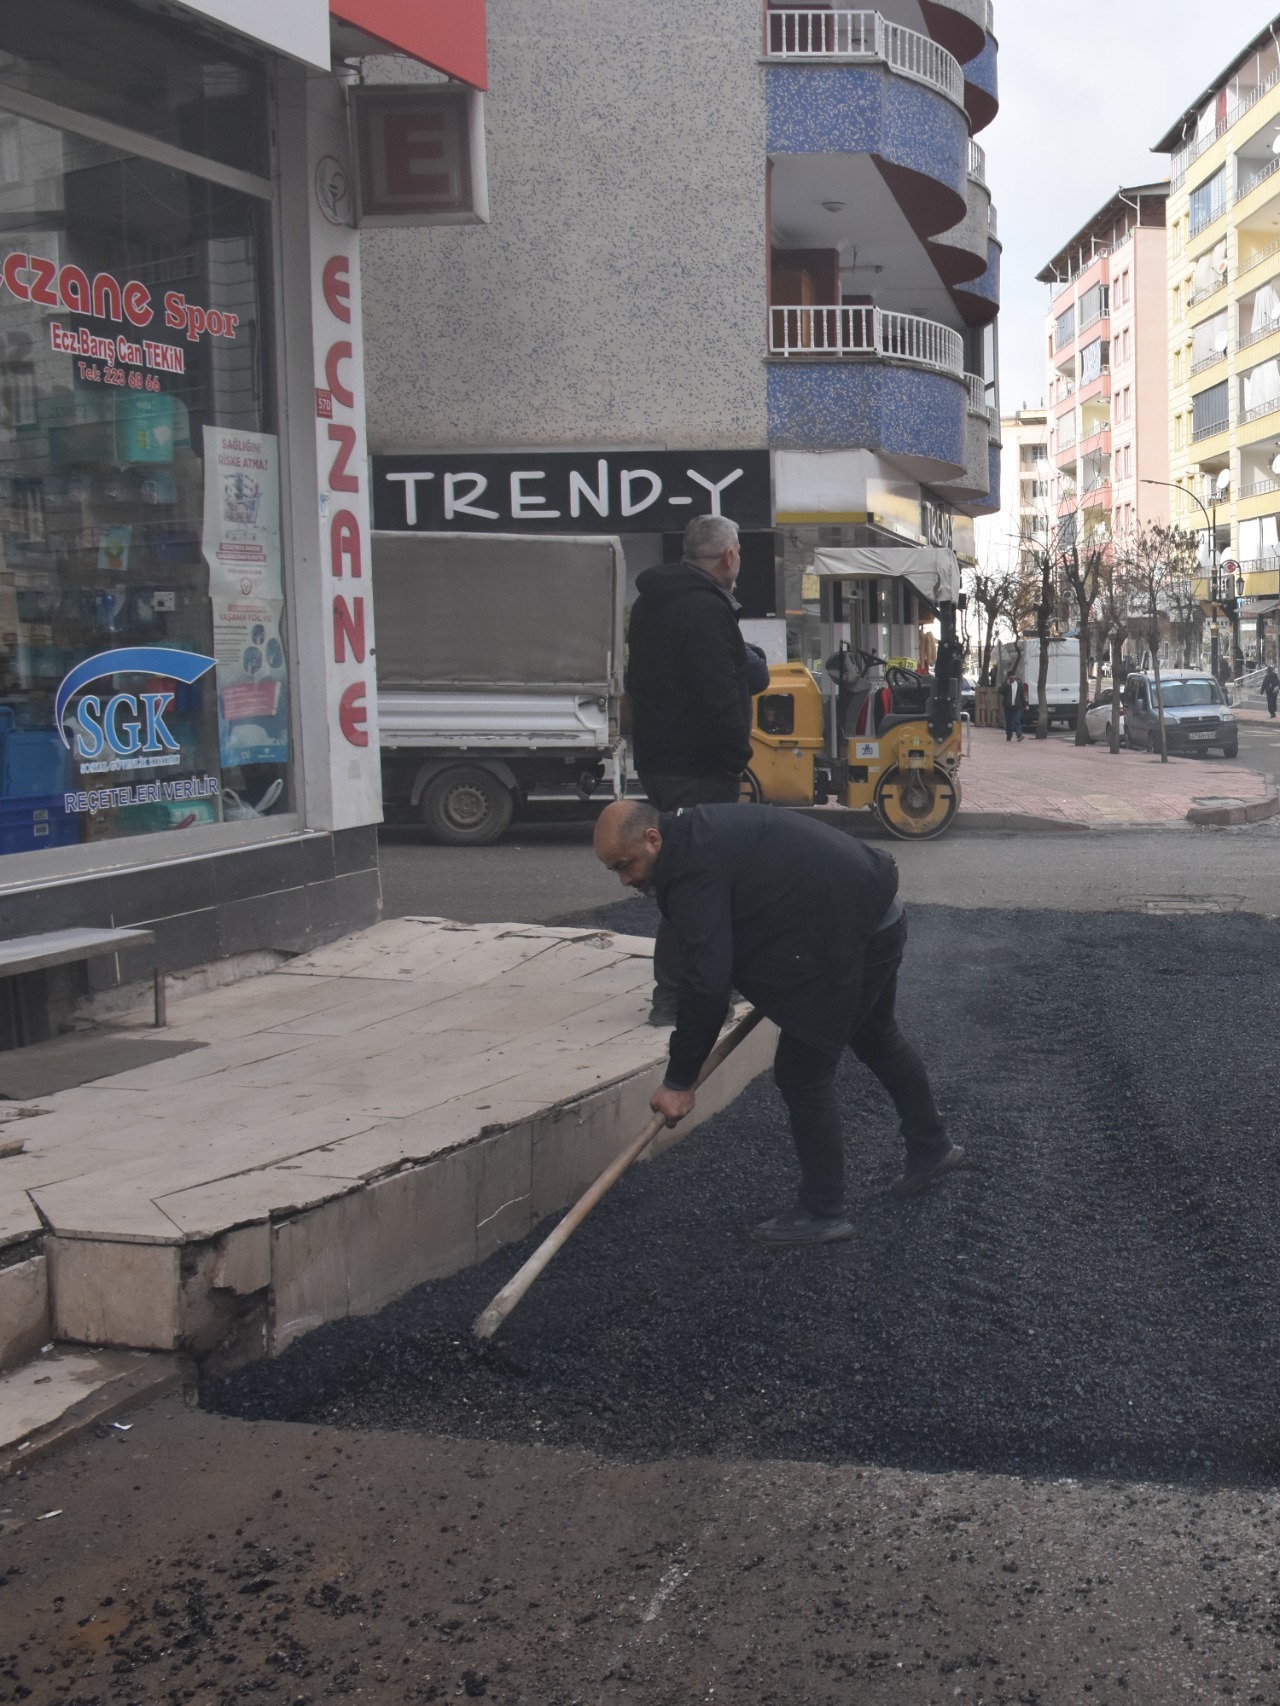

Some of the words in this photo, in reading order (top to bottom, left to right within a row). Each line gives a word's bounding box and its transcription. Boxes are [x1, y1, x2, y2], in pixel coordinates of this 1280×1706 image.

[385, 112, 450, 196] E
[0, 252, 154, 327] czane
[164, 291, 239, 342] Spor
[78, 362, 101, 382] Tel:
[103, 366, 126, 386] 223
[128, 371, 143, 389] 68
[145, 374, 161, 392] 66
[117, 335, 143, 366] Can
[322, 255, 370, 748] ECZANE
[386, 458, 744, 527] TREND-Y
[77, 693, 180, 759] SGK
[64, 779, 161, 814] REÇETELERİ
[163, 773, 219, 801] VERİLİR
